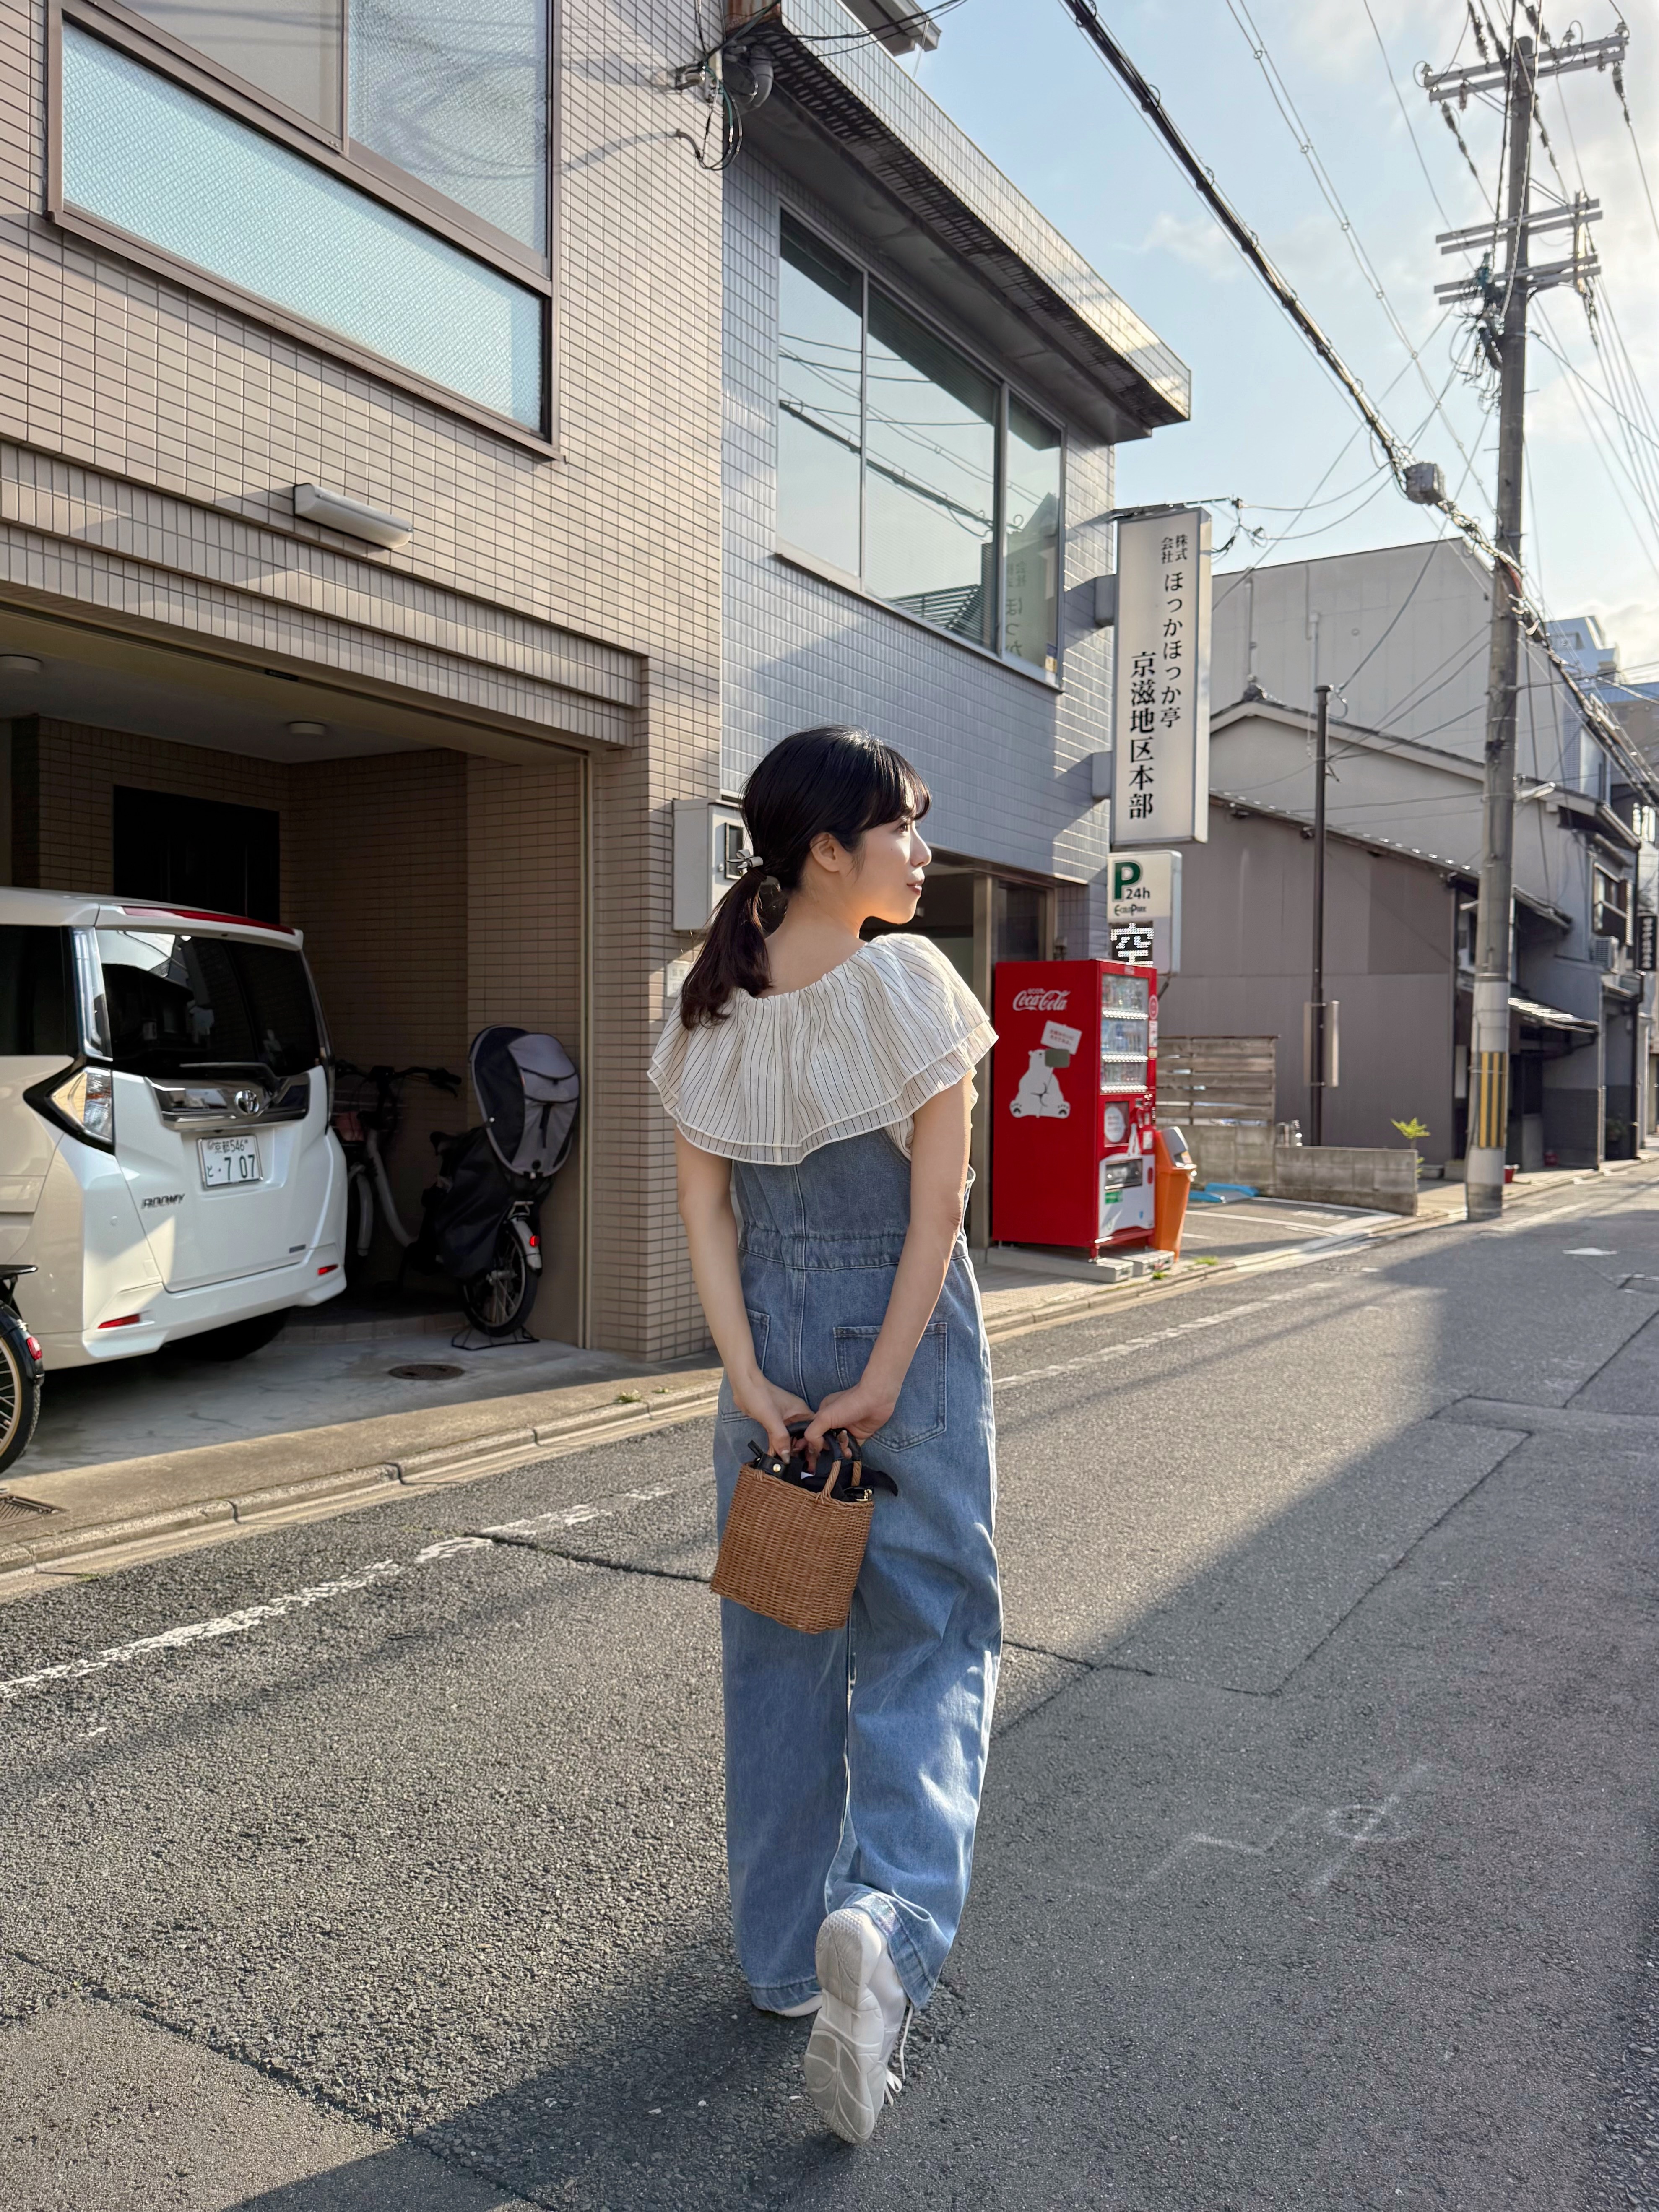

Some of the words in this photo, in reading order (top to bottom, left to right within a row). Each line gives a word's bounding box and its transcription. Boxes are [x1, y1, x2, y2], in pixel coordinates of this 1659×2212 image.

[1129, 651, 1157, 819] 京滋地区本部
[1114, 861, 1141, 900] P
[1126, 887, 1151, 900] 24h
[1110, 923, 1154, 967] 空
